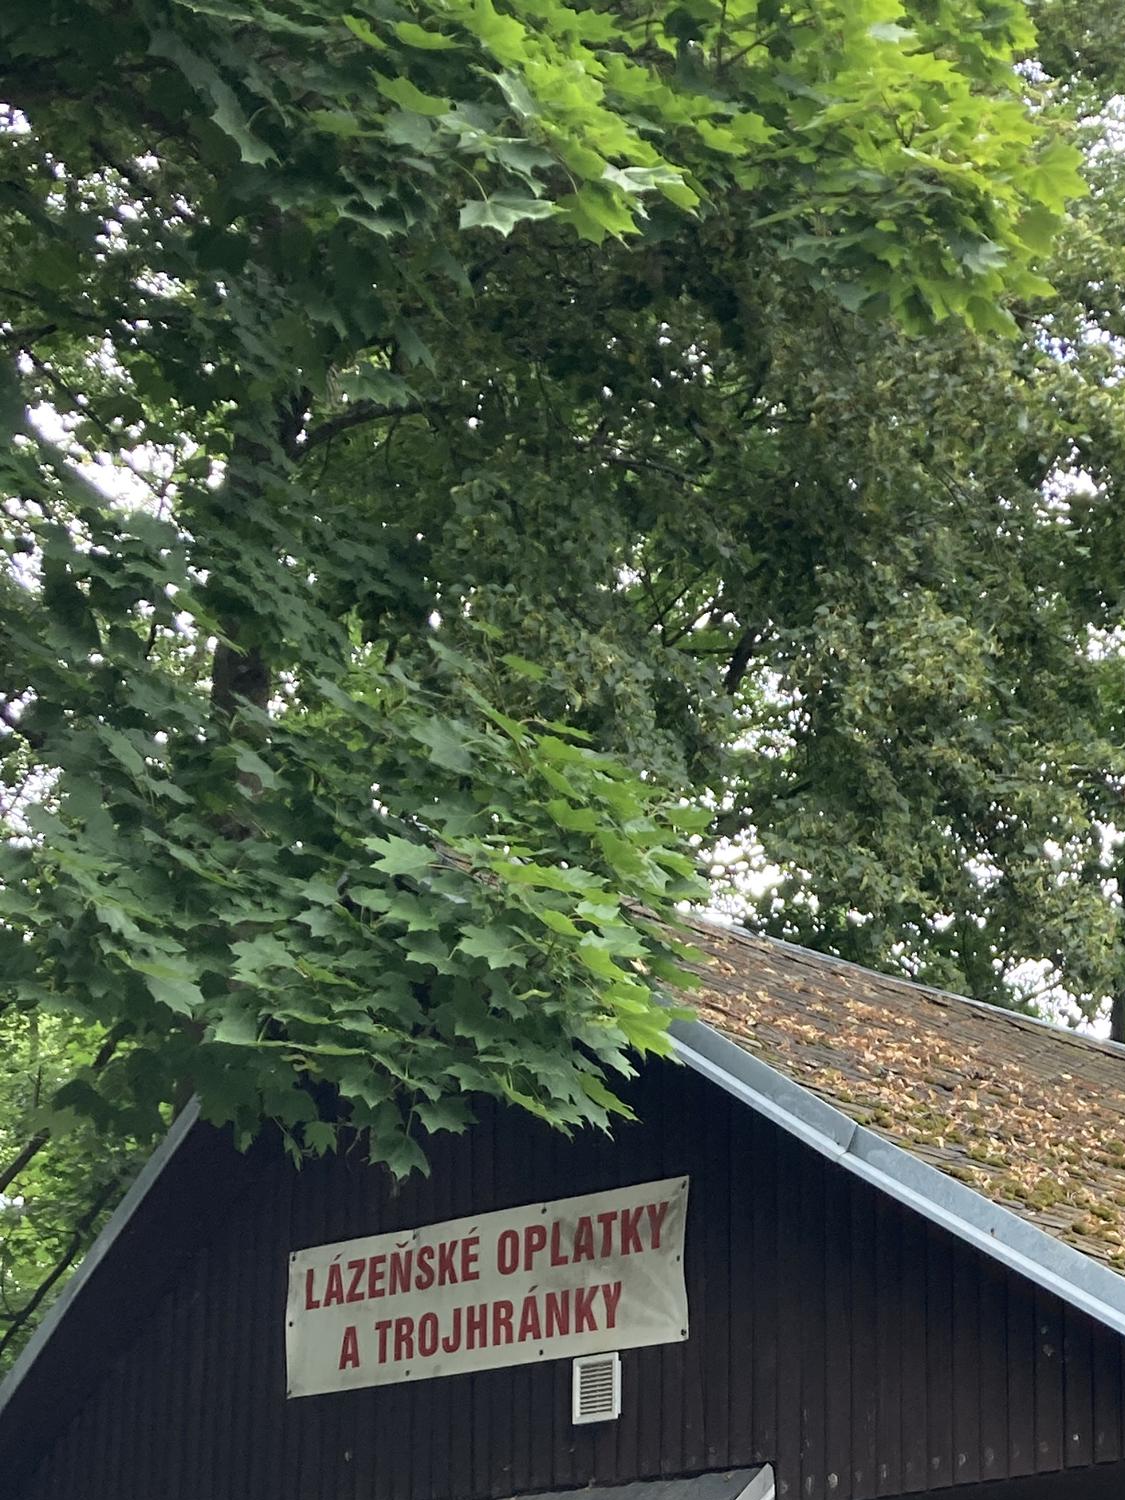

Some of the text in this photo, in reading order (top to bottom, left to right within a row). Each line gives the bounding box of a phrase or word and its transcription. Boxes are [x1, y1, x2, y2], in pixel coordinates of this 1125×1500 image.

[305, 1201, 669, 1310] LÁZEŇSKÉ OPLATKY
[338, 1281, 622, 1370] A TROJHRÁNKY
